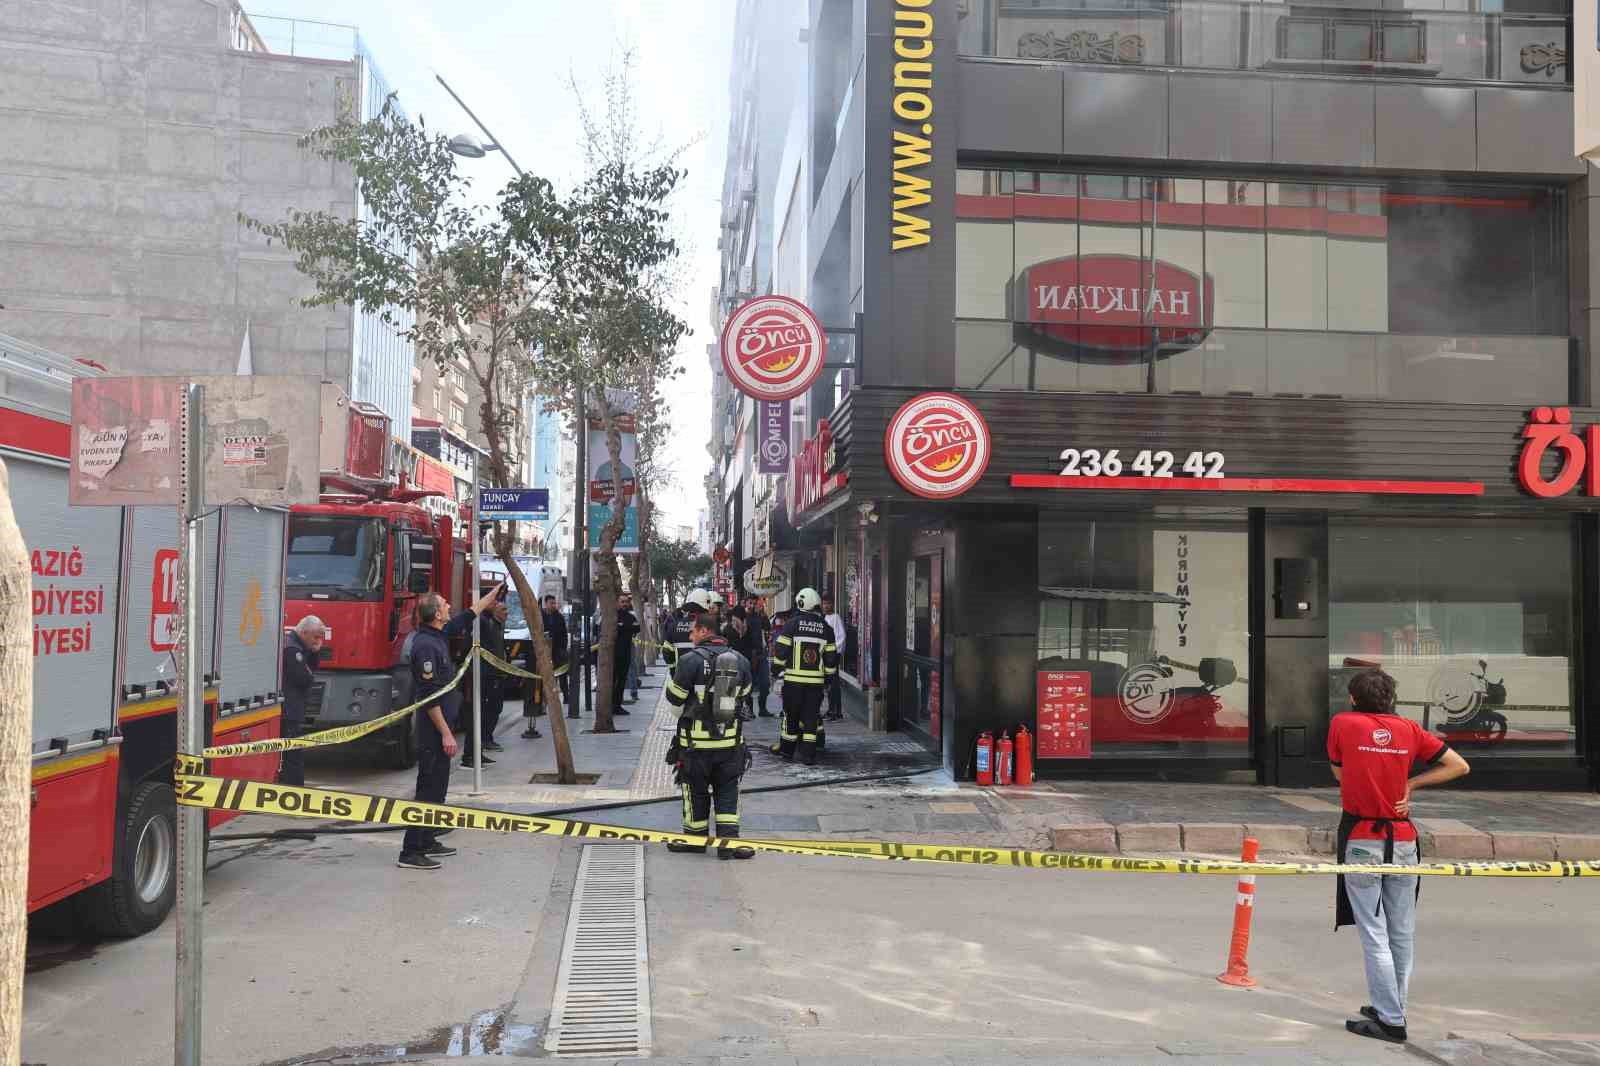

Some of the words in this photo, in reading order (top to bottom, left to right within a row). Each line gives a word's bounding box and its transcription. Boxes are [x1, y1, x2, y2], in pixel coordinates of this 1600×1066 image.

[892, 0, 933, 250] www.oncu
[1060, 449, 1122, 476] 236
[1131, 450, 1174, 478] 42
[1182, 451, 1225, 478] 42
[483, 494, 520, 503] TUNCAY
[31, 546, 83, 577] AZIĞ
[32, 584, 104, 616] DİYESİ
[33, 621, 91, 657] İYESİ
